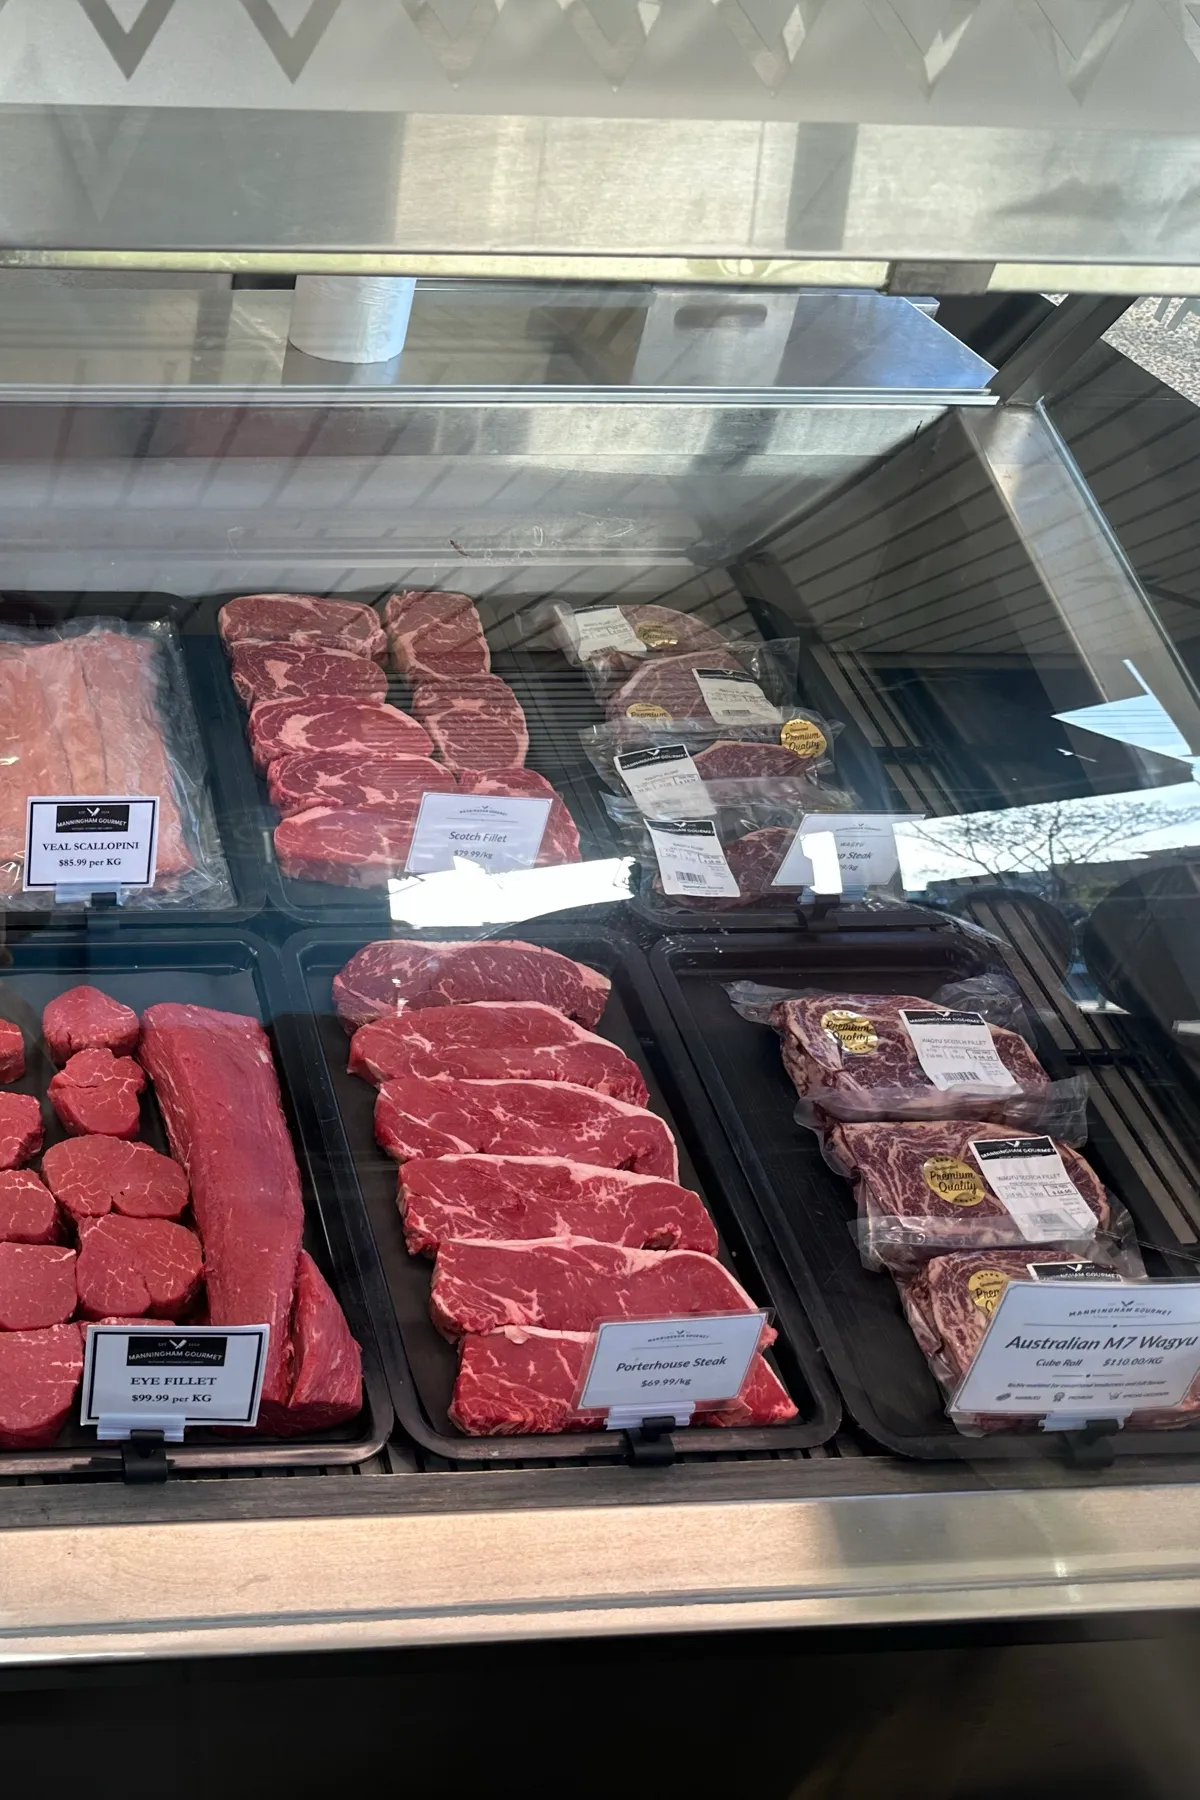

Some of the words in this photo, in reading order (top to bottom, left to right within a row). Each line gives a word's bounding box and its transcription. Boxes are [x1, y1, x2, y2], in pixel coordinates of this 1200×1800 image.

[786, 732, 822, 740] Premium
[788, 740, 820, 751] Quality
[56, 818, 98, 827] MANNINGHAM
[98, 818, 127, 826] GOURMET
[449, 831, 481, 841] Scotch
[483, 833, 508, 843] Fillet
[42, 843, 71, 851] VEAL
[74, 842, 139, 850] SCALLOPINI
[454, 850, 493, 860] $79.99/kg
[58, 859, 87, 867] $85.99
[89, 860, 104, 868] per
[106, 858, 122, 866] KG
[826, 1021, 872, 1033] Premium
[832, 1031, 869, 1042] Quality
[981, 1148, 1022, 1158] MANNINGHAM
[930, 1170, 975, 1180] Premium
[938, 1181, 977, 1195] Quality
[1069, 1308, 1133, 1317] MANNINGHAM
[1134, 1308, 1172, 1316] GOURMET
[1005, 1336, 1101, 1350] Australian
[1103, 1337, 1135, 1349] M7
[1139, 1336, 1199, 1350] Wagyu
[129, 1350, 183, 1360] MANNINGHAM
[185, 1351, 222, 1360] GOURMET
[616, 1361, 690, 1372] Porterhouse
[692, 1356, 727, 1367] Steak
[1036, 1358, 1061, 1367] Cube
[1063, 1359, 1083, 1367] Roll
[1103, 1356, 1164, 1367] $110.00/KG
[130, 1377, 160, 1385] EYE
[164, 1377, 217, 1386] FILLET
[640, 1378, 692, 1388] $69.99/kg
[131, 1394, 169, 1402] $99.99
[172, 1396, 189, 1404] per
[192, 1394, 212, 1402] KG
